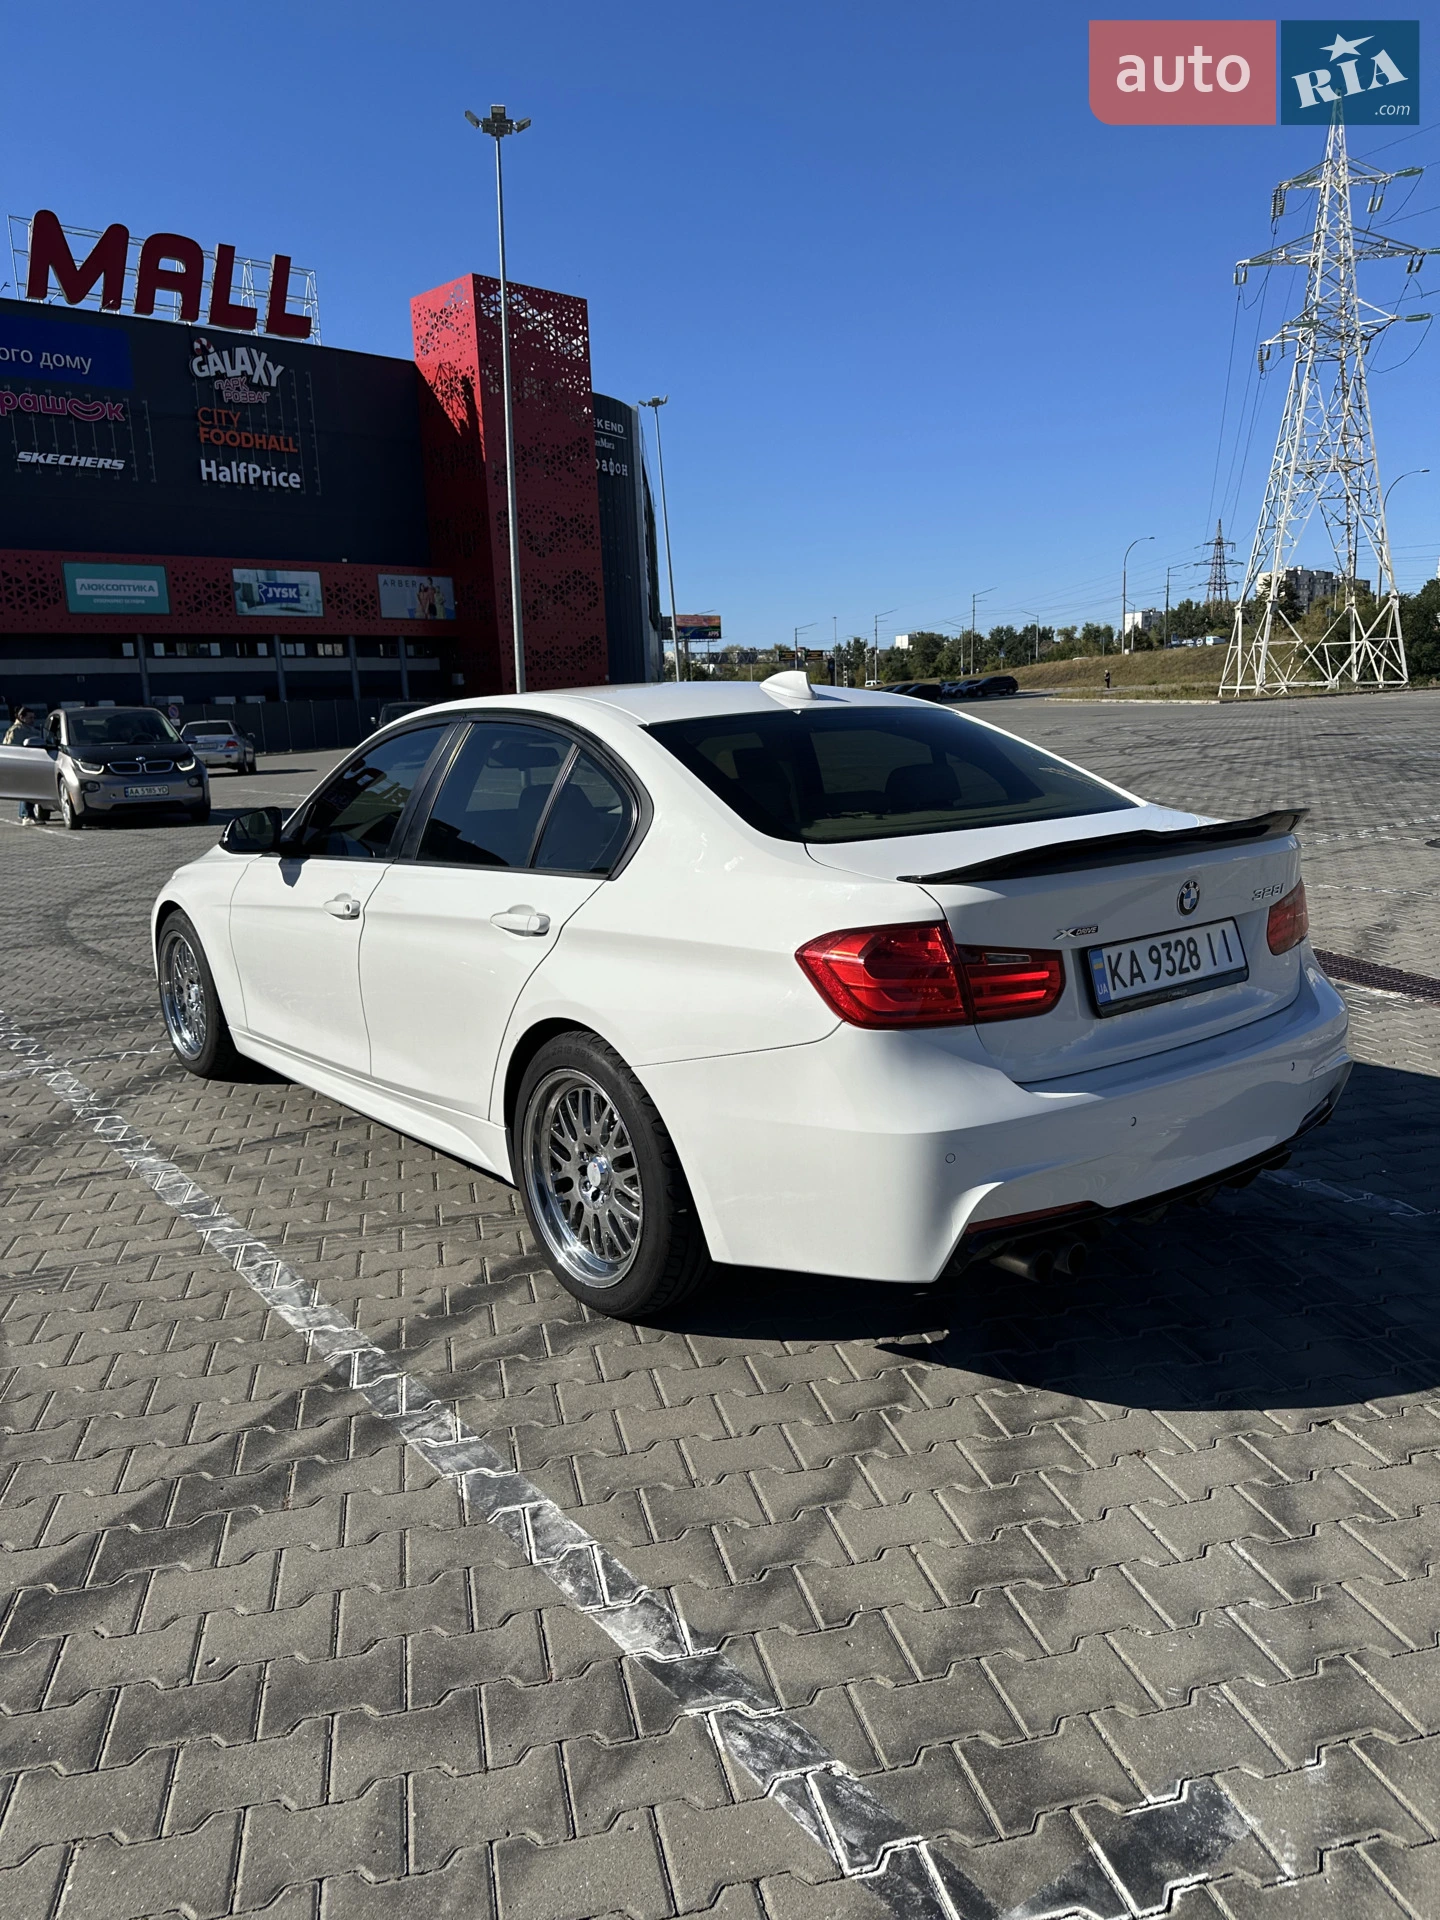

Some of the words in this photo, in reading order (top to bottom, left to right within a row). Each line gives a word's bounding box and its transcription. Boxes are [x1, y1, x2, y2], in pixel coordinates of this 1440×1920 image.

[25, 209, 312, 339] MALL
[40, 352, 92, 375] дому
[191, 347, 285, 387] GALAXY
[197, 406, 241, 428] CITY
[199, 427, 299, 453] FOODHALL
[17, 451, 126, 471] SKECHERS
[200, 459, 301, 489] HalfPrice
[79, 583, 156, 593] ЛЮКСОПТИКА
[266, 587, 299, 599] JYSK
[382, 578, 417, 588] ARBER
[1107, 950, 1147, 992] KA
[1149, 936, 1201, 982] 9328
[1206, 929, 1233, 967] II
[1097, 983, 1110, 995] UA
